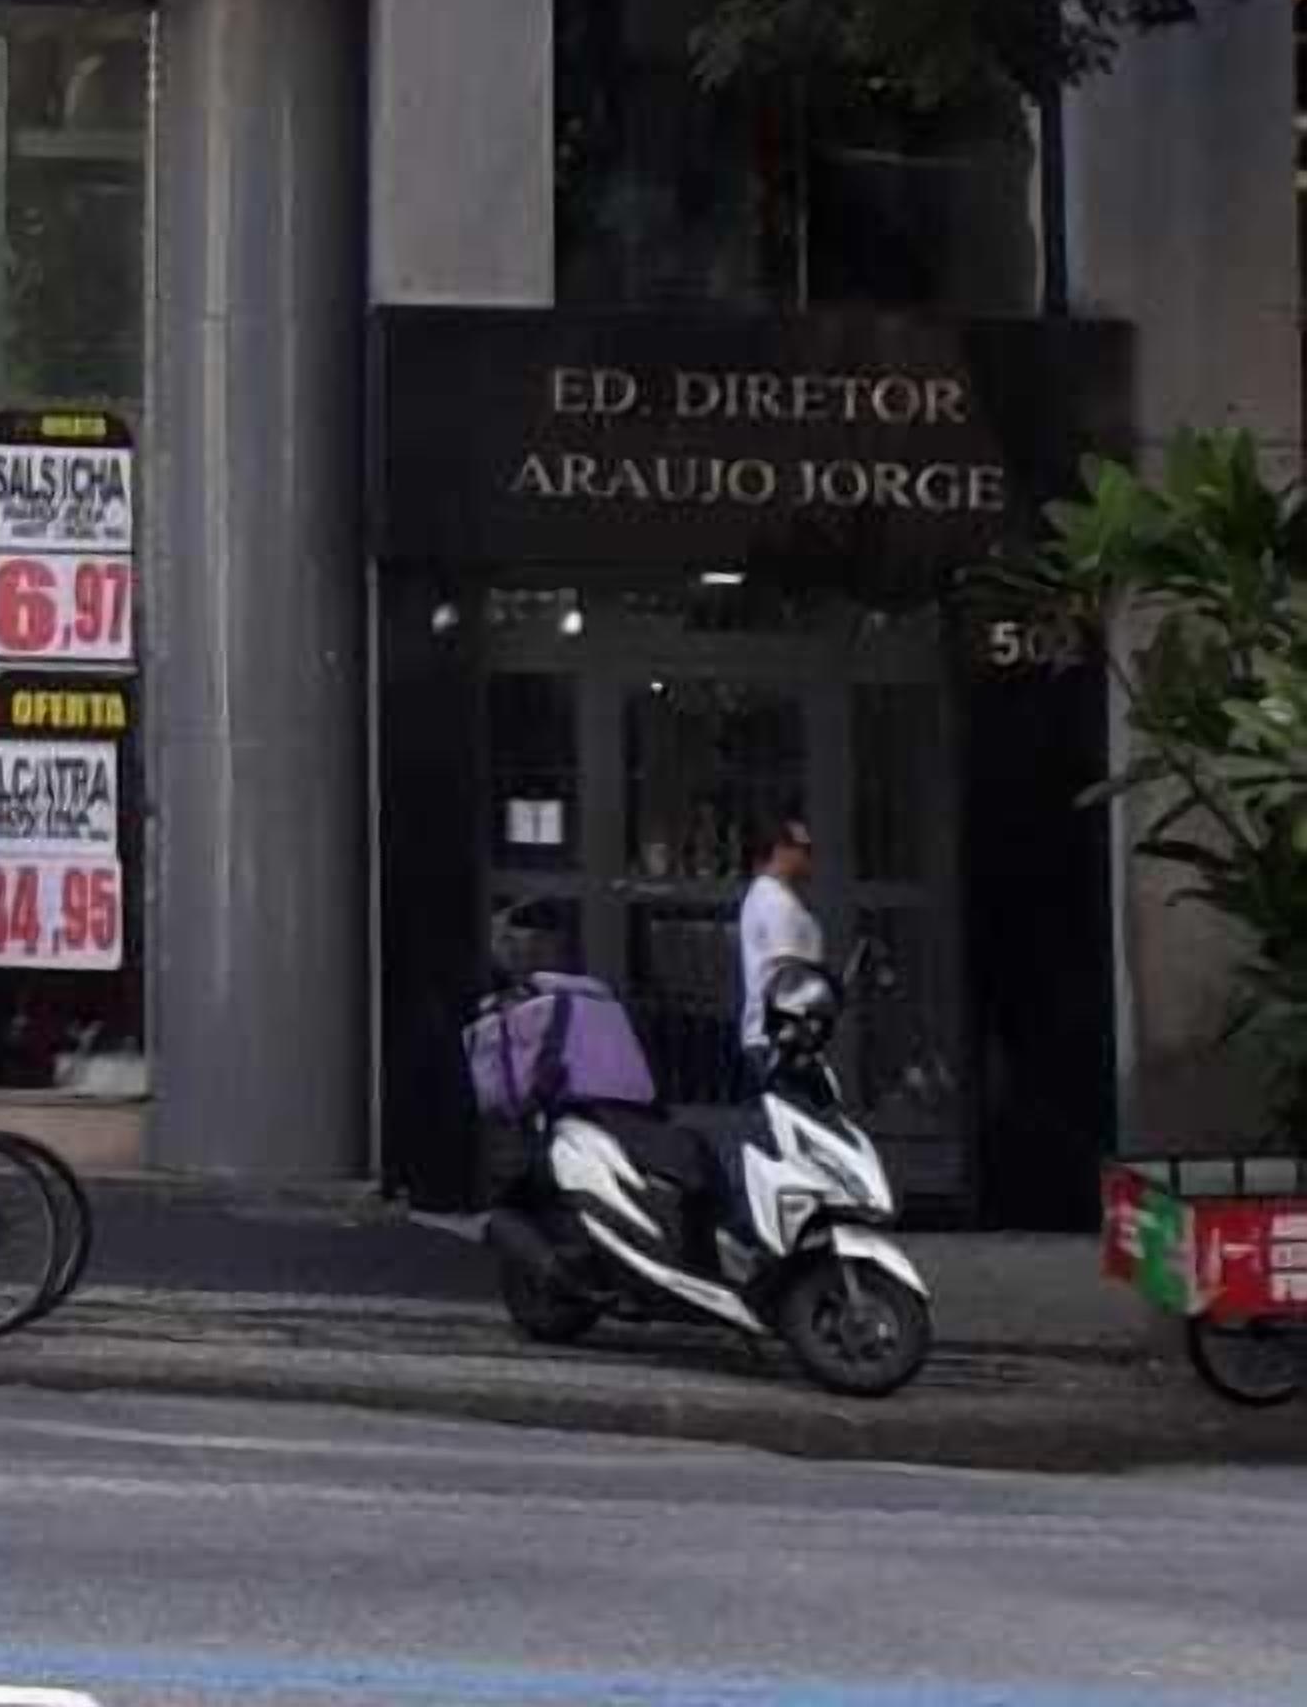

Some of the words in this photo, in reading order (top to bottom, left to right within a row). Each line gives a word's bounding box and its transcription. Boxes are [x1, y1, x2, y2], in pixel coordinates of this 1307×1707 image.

[675, 370, 969, 425] DIRETOR
[512, 451, 777, 505] ARAUJO
[797, 459, 1005, 513] JORGE
